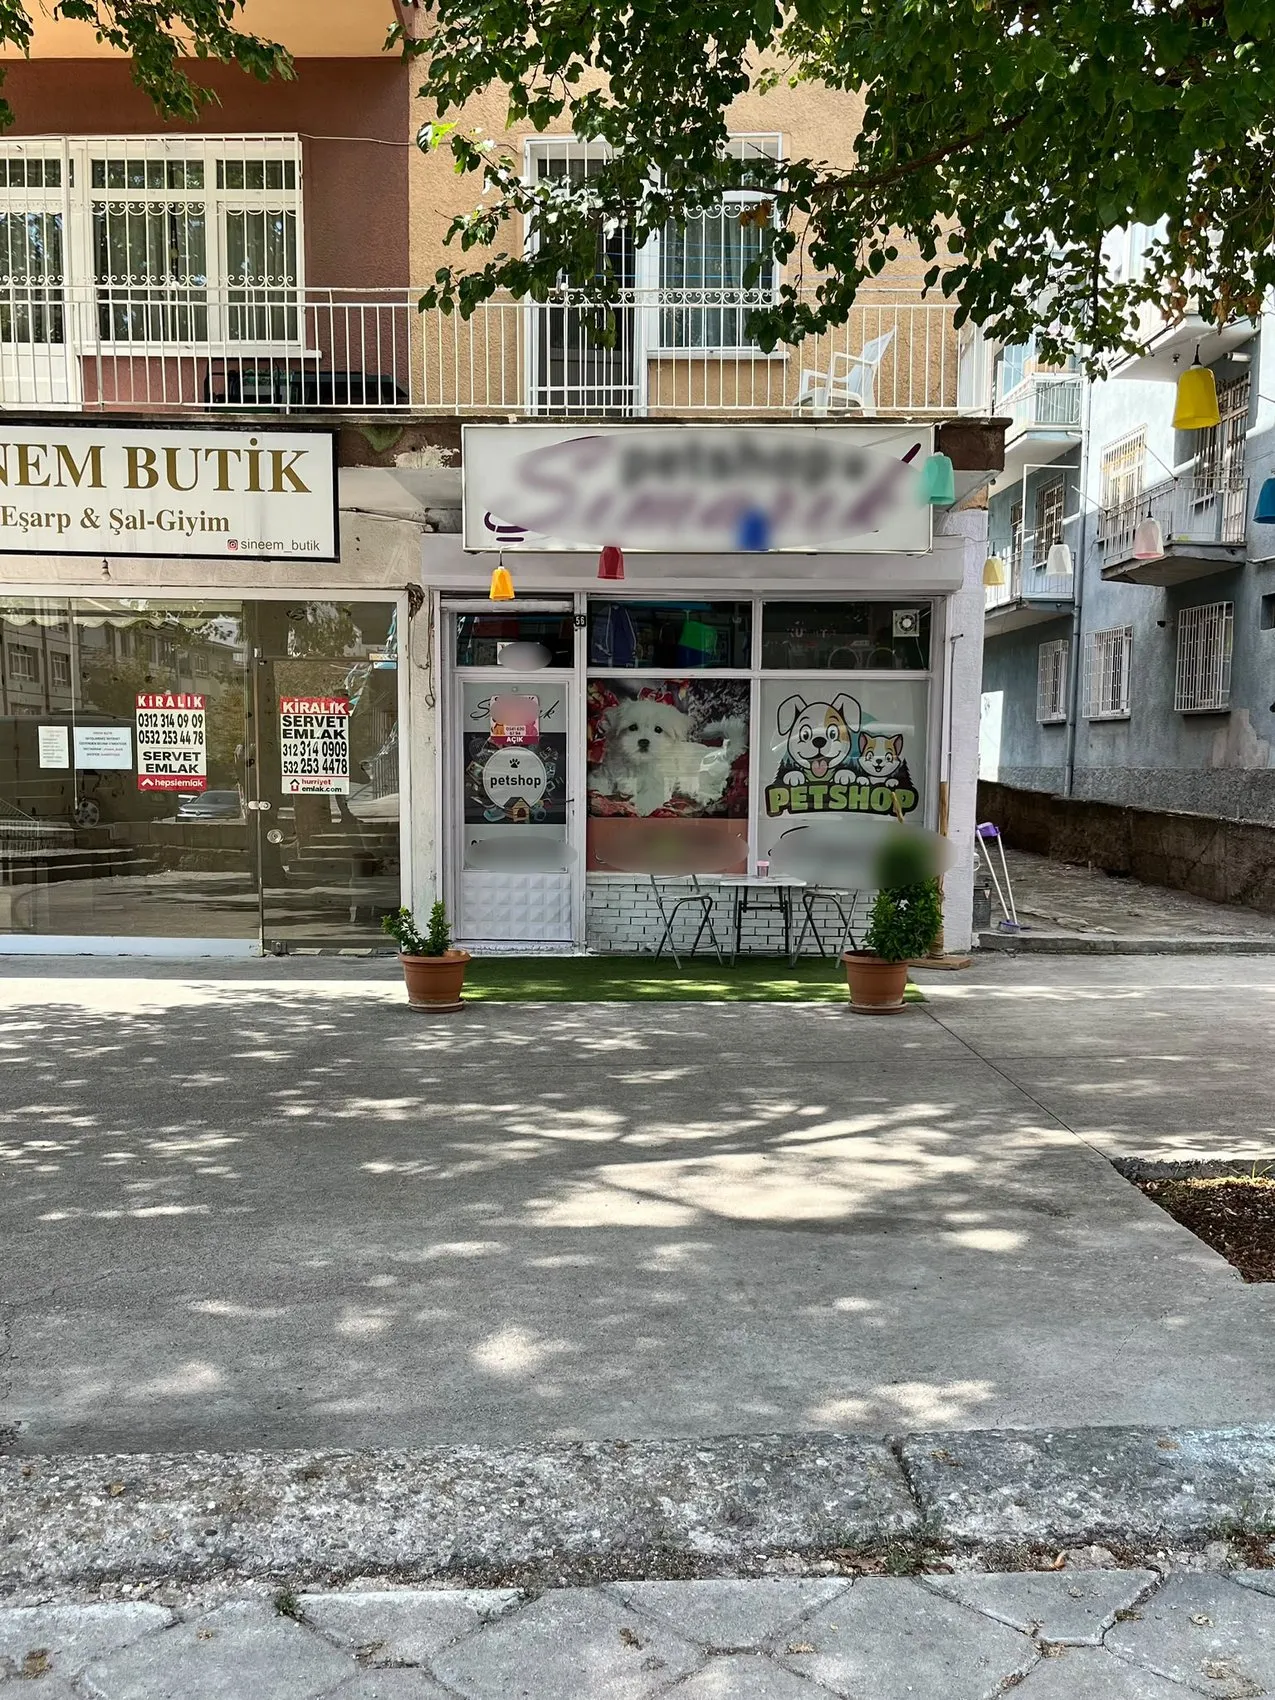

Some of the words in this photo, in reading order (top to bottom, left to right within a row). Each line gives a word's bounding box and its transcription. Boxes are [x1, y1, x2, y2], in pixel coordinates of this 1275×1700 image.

[0, 443, 107, 488] EM
[122, 438, 312, 493] BUTİK
[0, 506, 71, 533] Eşarp
[80, 507, 101, 529] &
[109, 508, 230, 536] Şal-Giyim
[240, 539, 320, 553] sineem_butik
[138, 713, 158, 727] 0312
[160, 713, 175, 728] 314
[177, 714, 189, 728] 09
[191, 714, 203, 728] 09
[282, 715, 346, 728] SERVET
[138, 730, 160, 744] 0532
[162, 730, 178, 744] 253
[180, 731, 191, 745] 44
[193, 731, 204, 745] 78
[506, 736, 523, 744] AÇIK
[143, 751, 201, 761] SERVET
[282, 744, 298, 756] 312
[300, 740, 318, 757] 314
[321, 741, 347, 757] 0909
[145, 763, 199, 773] EMLAK
[283, 761, 299, 774] 532
[300, 758, 319, 774] 253
[322, 758, 348, 774] 4478
[490, 774, 541, 788] petshop
[768, 785, 915, 813] PETSHOP
